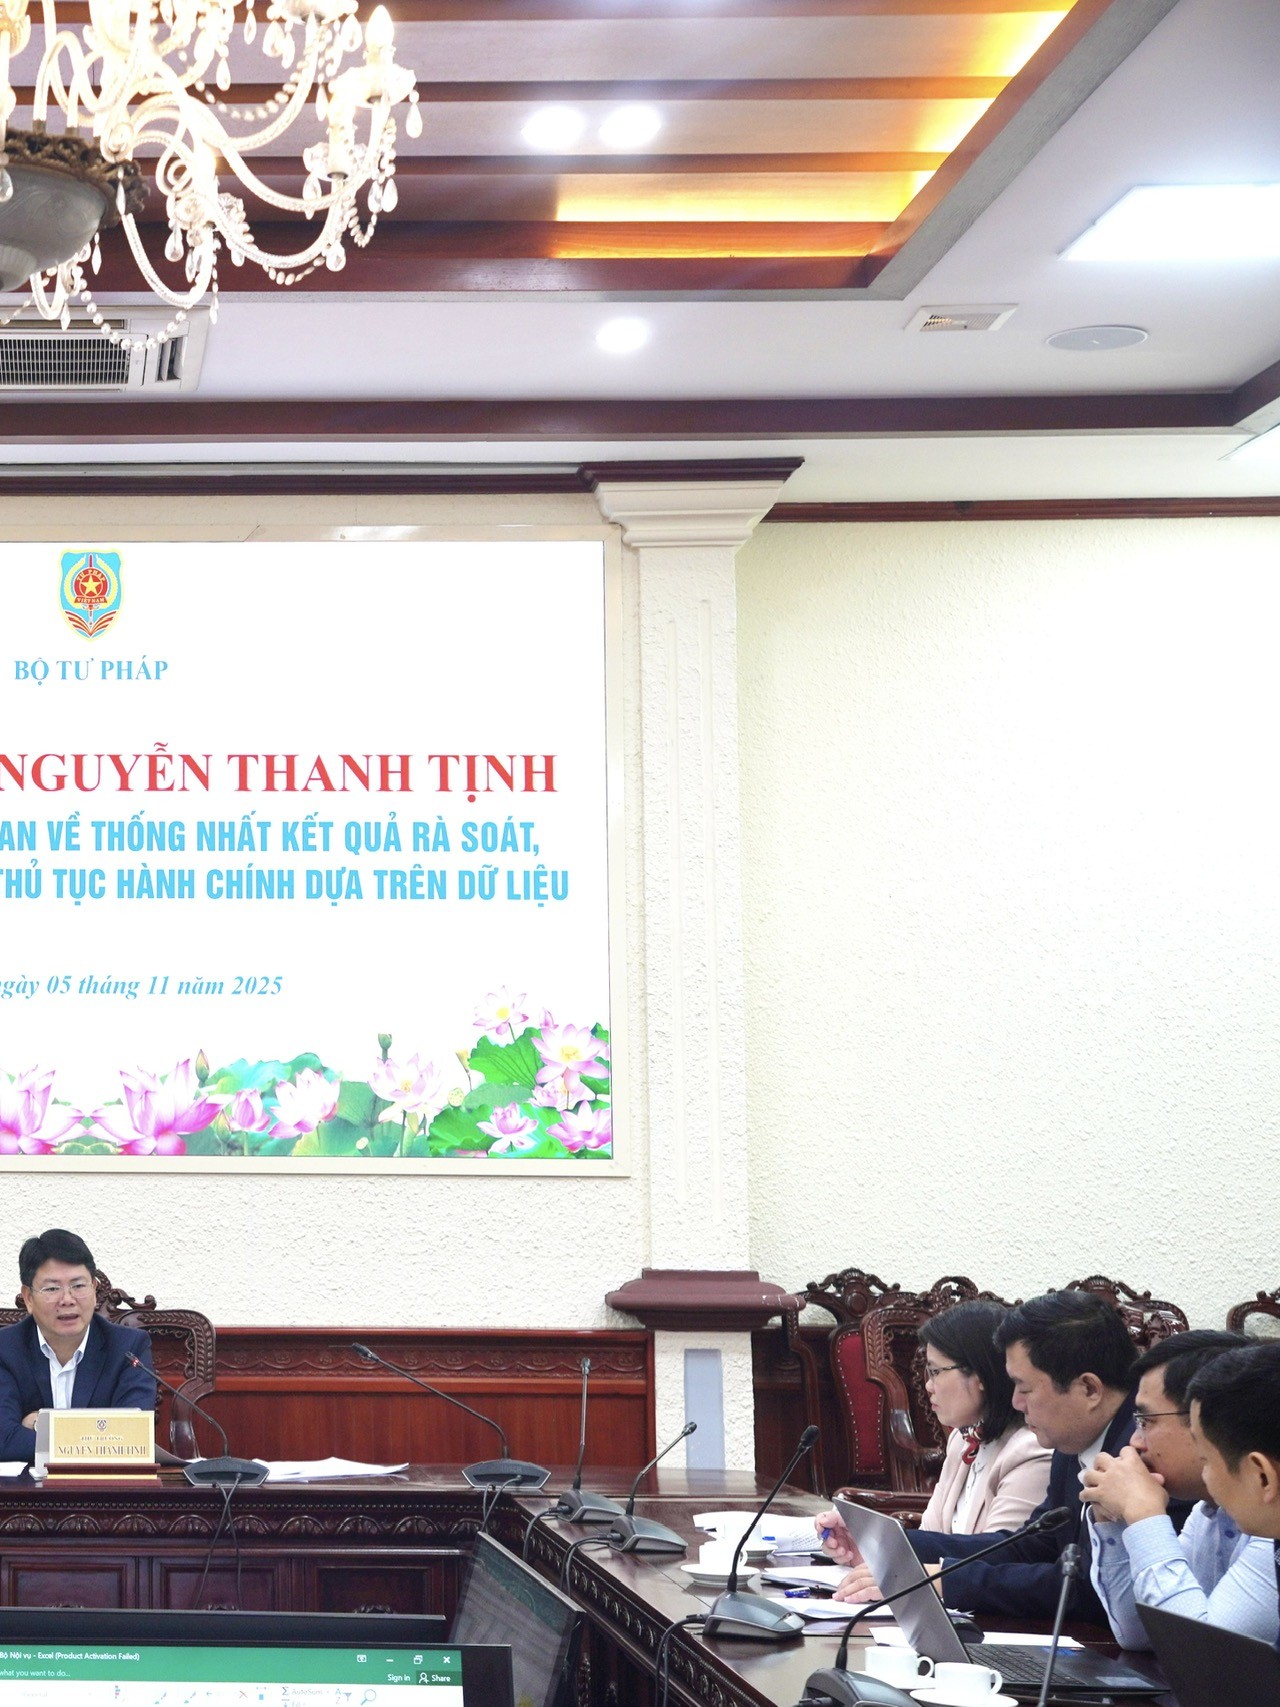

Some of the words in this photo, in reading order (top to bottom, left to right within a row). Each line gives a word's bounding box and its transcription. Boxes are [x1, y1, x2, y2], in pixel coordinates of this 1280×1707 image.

[14, 657, 49, 686] BỘ
[56, 657, 94, 681] TƯ
[100, 655, 169, 681] PHÁP
[227, 754, 413, 792] THANH
[428, 755, 557, 803] TỊNH
[47, 811, 81, 851] VỀ
[91, 810, 185, 852] THỐNG
[196, 810, 272, 852] NHẤT
[282, 811, 334, 852] KẾT
[344, 811, 402, 856] QUẢ
[412, 816, 450, 852] RÀ
[461, 816, 539, 856] SOÁT,
[52, 868, 106, 906] TỤC
[117, 862, 195, 899] HÀNH
[206, 863, 294, 900] CHÍNH
[306, 866, 363, 906] DỰA
[373, 864, 447, 900] TRÊN
[458, 863, 499, 900] DỮ
[507, 864, 569, 908] LIỆU
[47, 975, 72, 994] 05
[78, 975, 141, 1000] tháng
[148, 976, 170, 995] 11
[177, 976, 225, 995] năm
[231, 976, 284, 996] 2025
[38, 1652, 54, 1660] Excel
[55, 1652, 83, 1661] (Product
[84, 1652, 117, 1660] Activation
[118, 1653, 140, 1662] Failed)
[16, 1671, 29, 1679] you
[387, 1674, 403, 1682] Sign
[432, 1674, 451, 1682] Share
